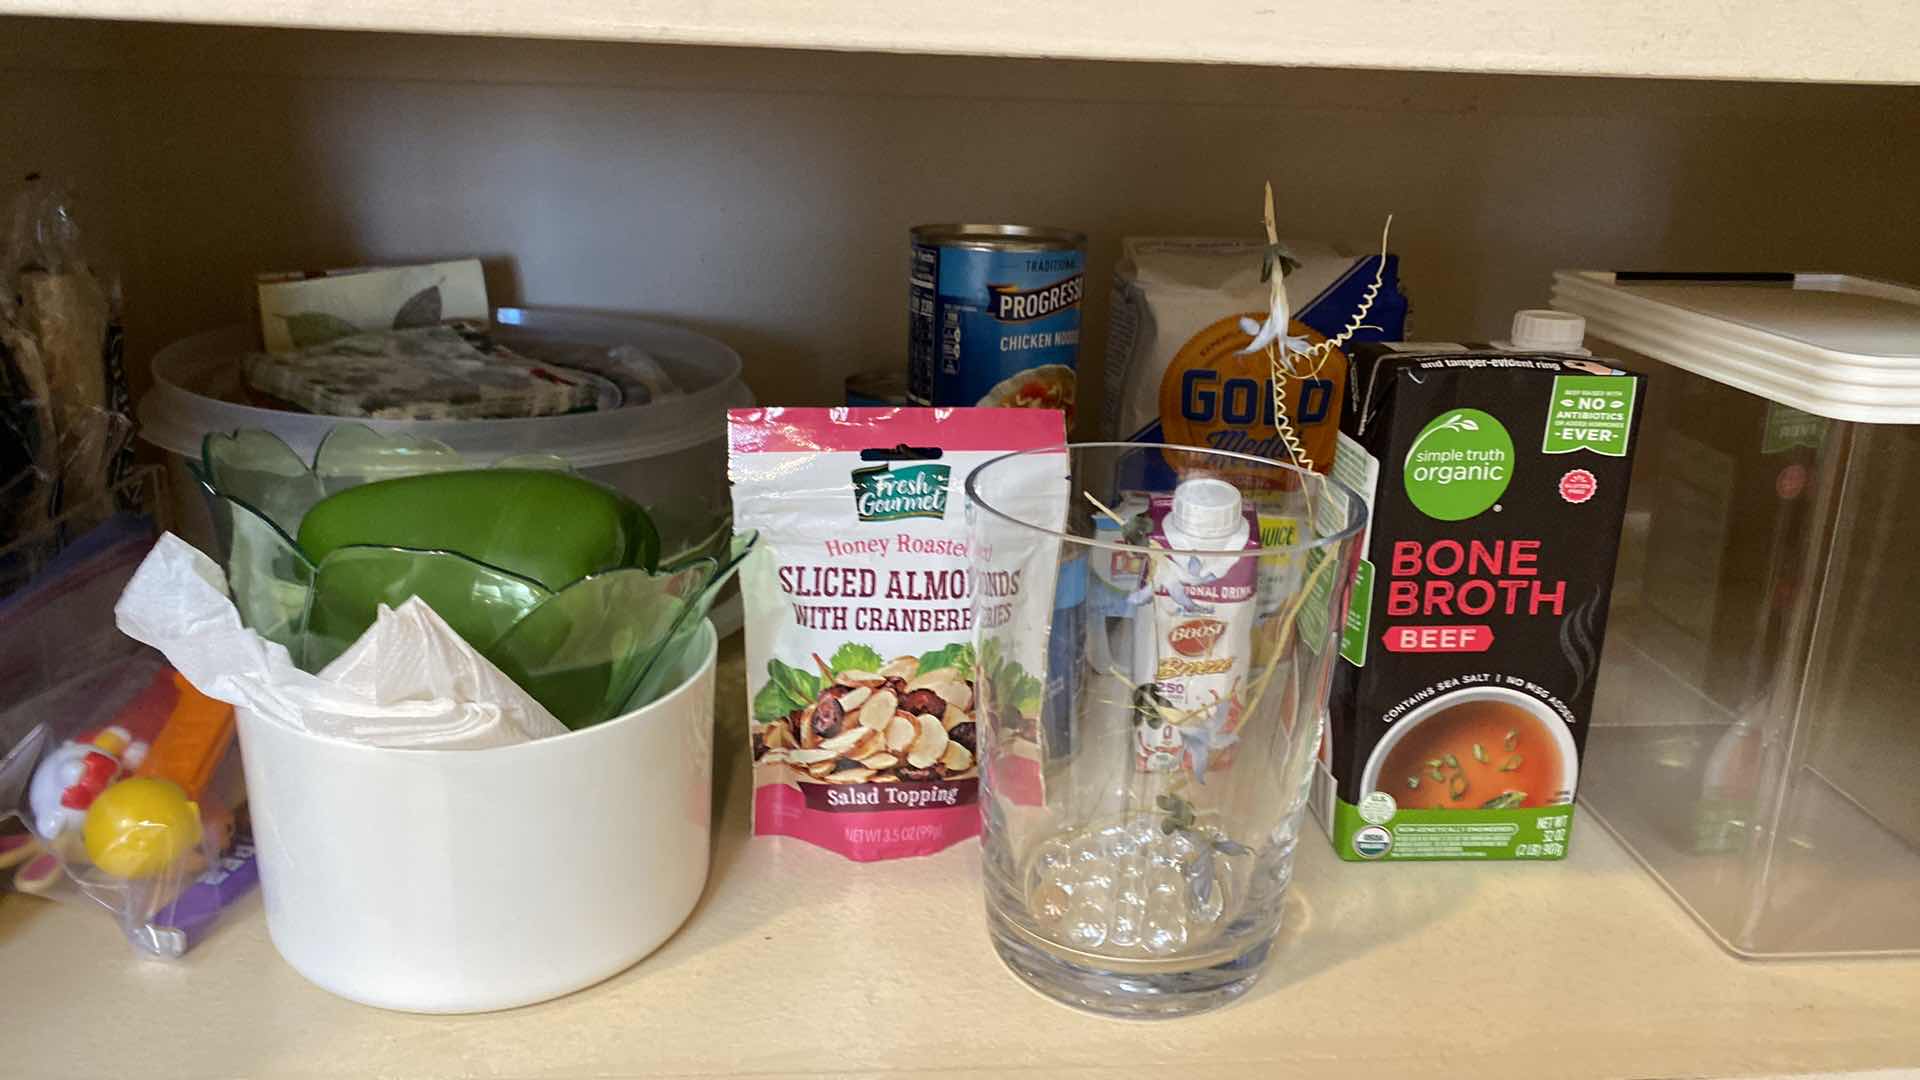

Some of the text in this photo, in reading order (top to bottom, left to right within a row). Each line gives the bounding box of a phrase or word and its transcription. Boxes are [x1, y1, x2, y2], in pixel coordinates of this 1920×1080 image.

[1001, 332, 1053, 352] CHICKEN
[1420, 358, 1562, 372] and tamper-evident ring
[1556, 411, 1625, 421] ANTIBIOTICS
[1578, 398, 1606, 411] NO
[1416, 448, 1505, 463] simple truth
[872, 471, 932, 497] Fresh
[1413, 462, 1505, 485] organic
[858, 492, 944, 516] Gourmet
[824, 535, 890, 559] Honey
[1391, 539, 1542, 577] BONE
[778, 566, 877, 597] SLICED
[1386, 579, 1567, 616] BROTH
[791, 602, 848, 631] WITH
[1399, 629, 1478, 649] BEEF
[1382, 672, 1577, 724] CONTAINS SEA SALT NO MSG ADDED
[826, 786, 960, 807] Salad Topping
